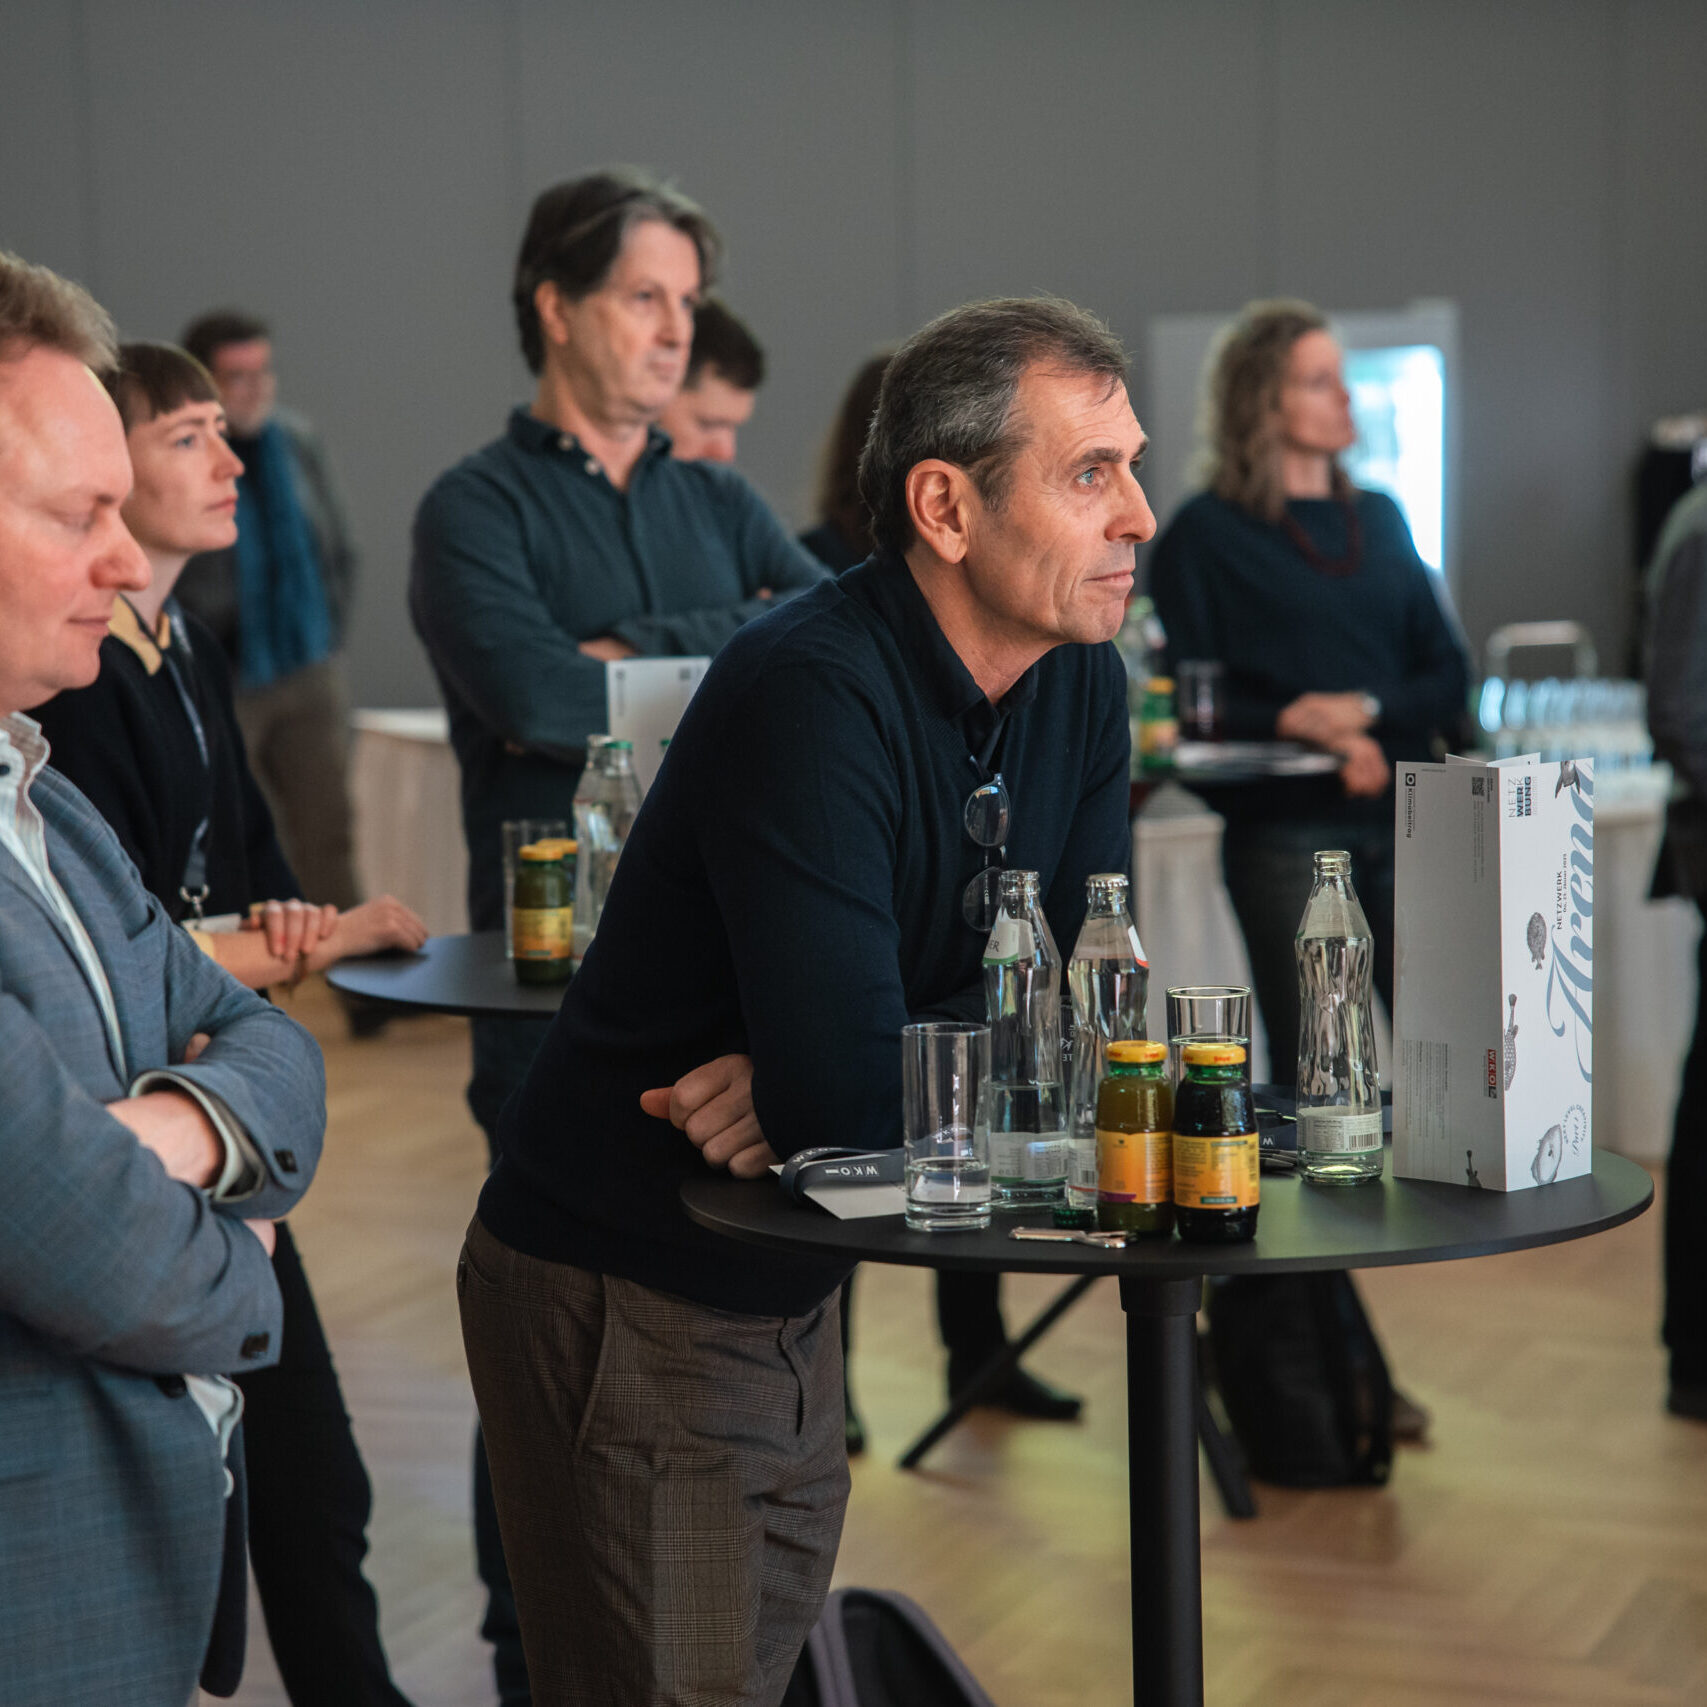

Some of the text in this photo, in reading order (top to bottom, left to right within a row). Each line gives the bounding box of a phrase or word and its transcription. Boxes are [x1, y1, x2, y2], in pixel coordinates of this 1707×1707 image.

[1508, 777, 1517, 818] NETZ
[1517, 777, 1525, 817] WERK
[1524, 775, 1532, 816] BUNG
[1488, 1050, 1497, 1085] WKO
[840, 1165, 878, 1176] WKO
